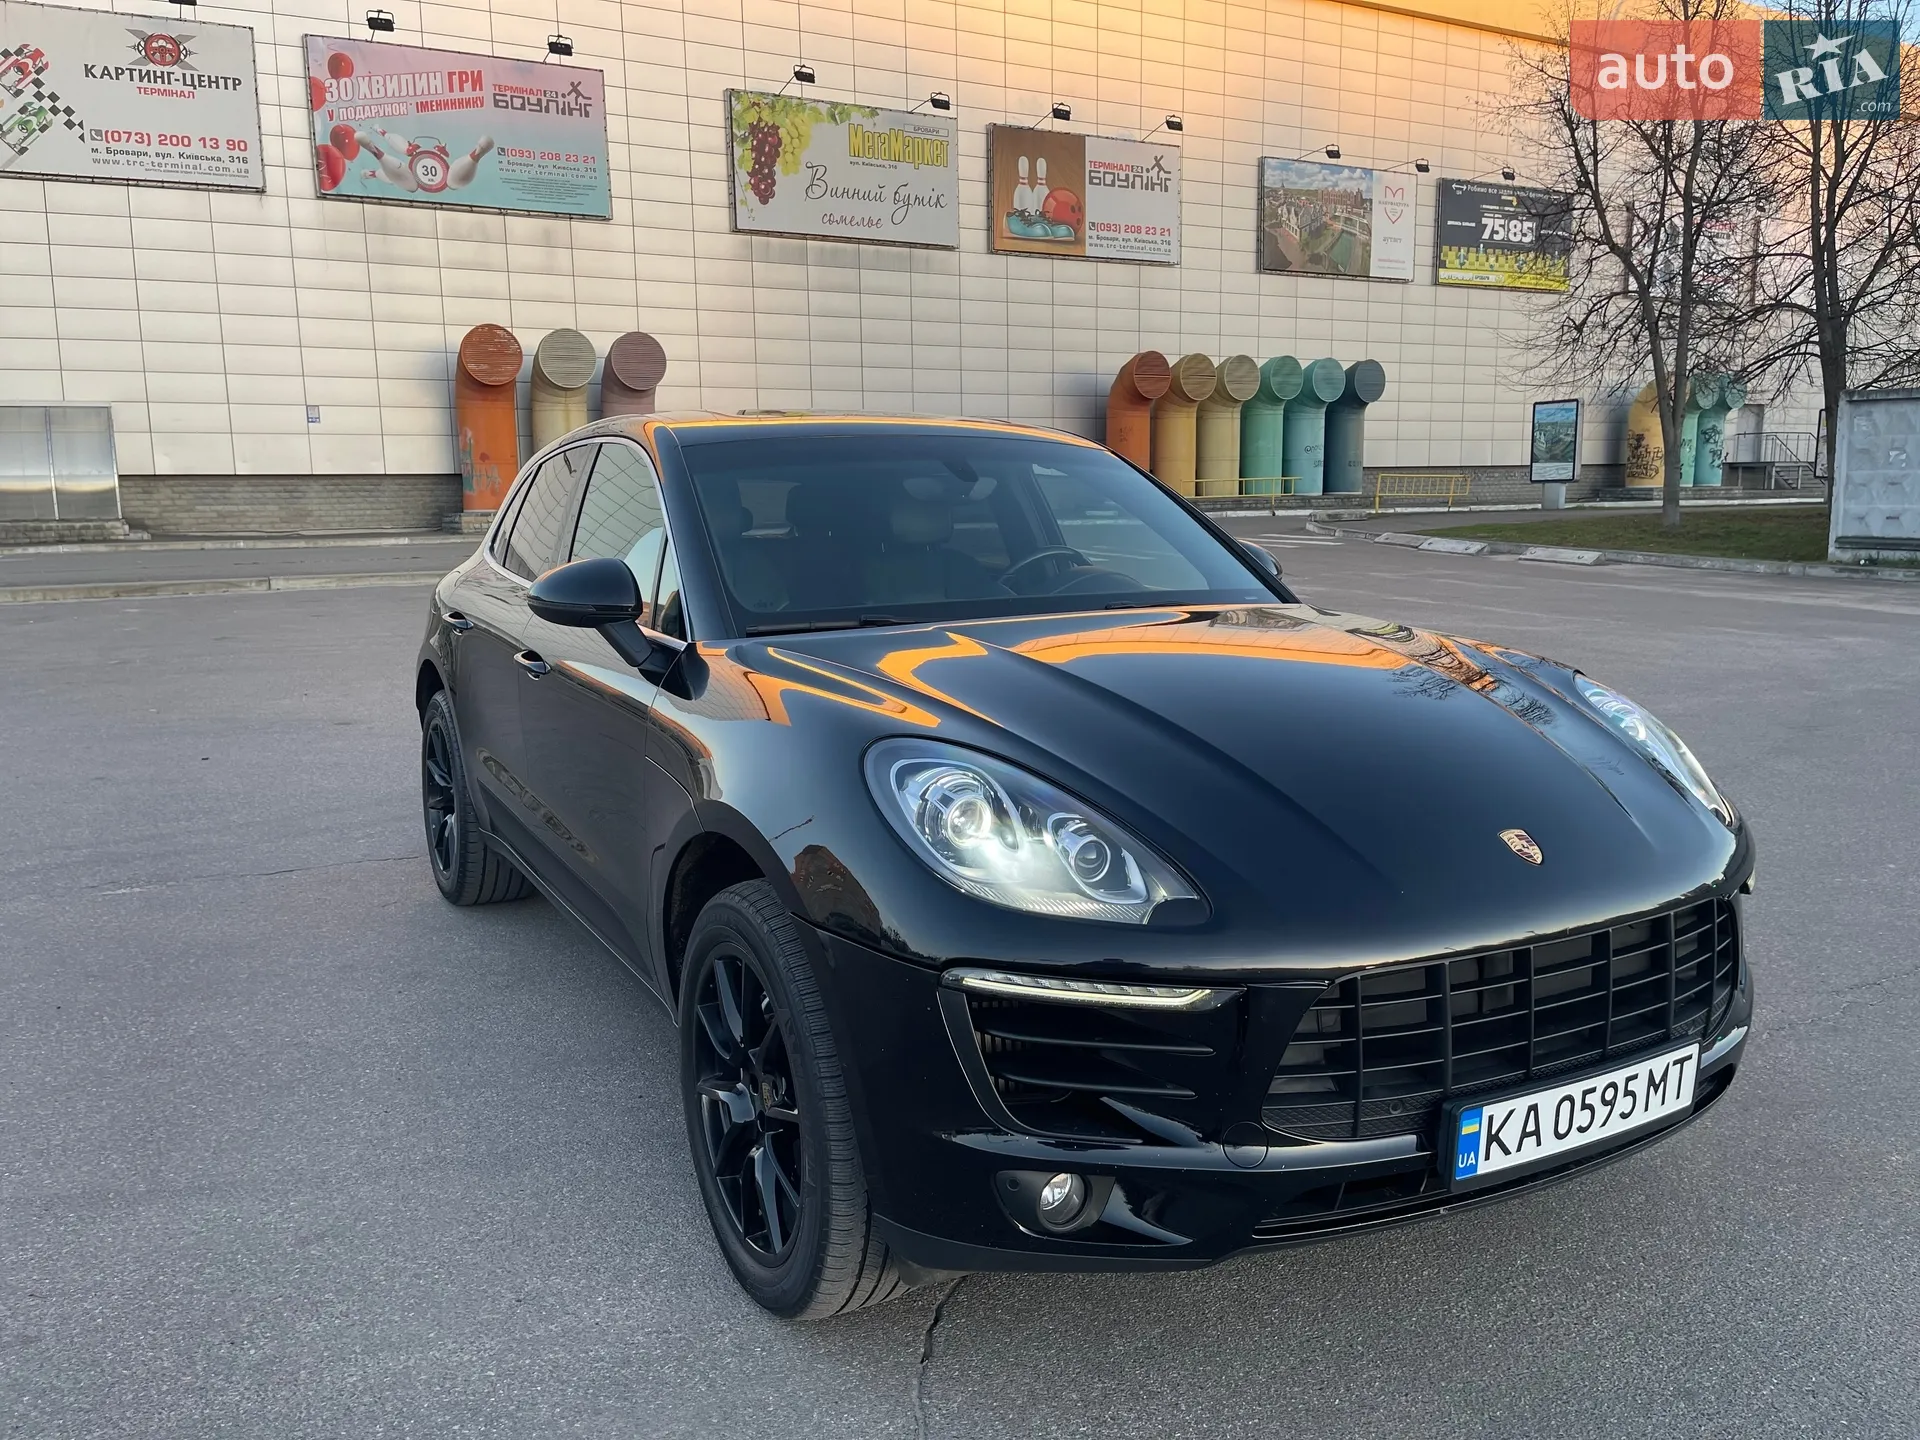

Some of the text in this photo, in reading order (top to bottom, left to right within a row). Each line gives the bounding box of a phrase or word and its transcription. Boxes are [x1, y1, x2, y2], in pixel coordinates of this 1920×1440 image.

[84, 64, 242, 91] КАРТИНГ-ЦЕНТР
[325, 70, 484, 103] 30 ХВИЛИН ГРИ
[136, 86, 196, 99] ТЕРМІНАЛ
[492, 83, 542, 97] ТЕРМІНАЛ
[327, 96, 485, 121] У ПОДАРУНОК ІМЕНИННИКУ
[493, 92, 592, 118] БОУЛІНГ
[104, 130, 248, 152] (073) 200 13 90
[848, 123, 950, 170] МегаМаркет
[92, 157, 249, 175] www.trc-terminal.com.ua
[106, 147, 152, 158] Бровари,
[155, 152, 175, 160] вул.
[178, 152, 225, 163] Київська,
[506, 148, 596, 165] (093) 208 23 21
[1089, 160, 1130, 172] ТЕРМІНАЛ
[422, 165, 437, 177] 30
[1089, 170, 1172, 192] БОУЛІНГ
[805, 161, 948, 225] Винний бутік
[822, 212, 883, 229] сомельє
[1096, 222, 1171, 237] (093) 208 23 21
[1481, 217, 1505, 241] 75
[1508, 219, 1534, 243] 85
[1484, 1053, 1694, 1161] KA 0595 MT
[1458, 1150, 1477, 1168] UA
